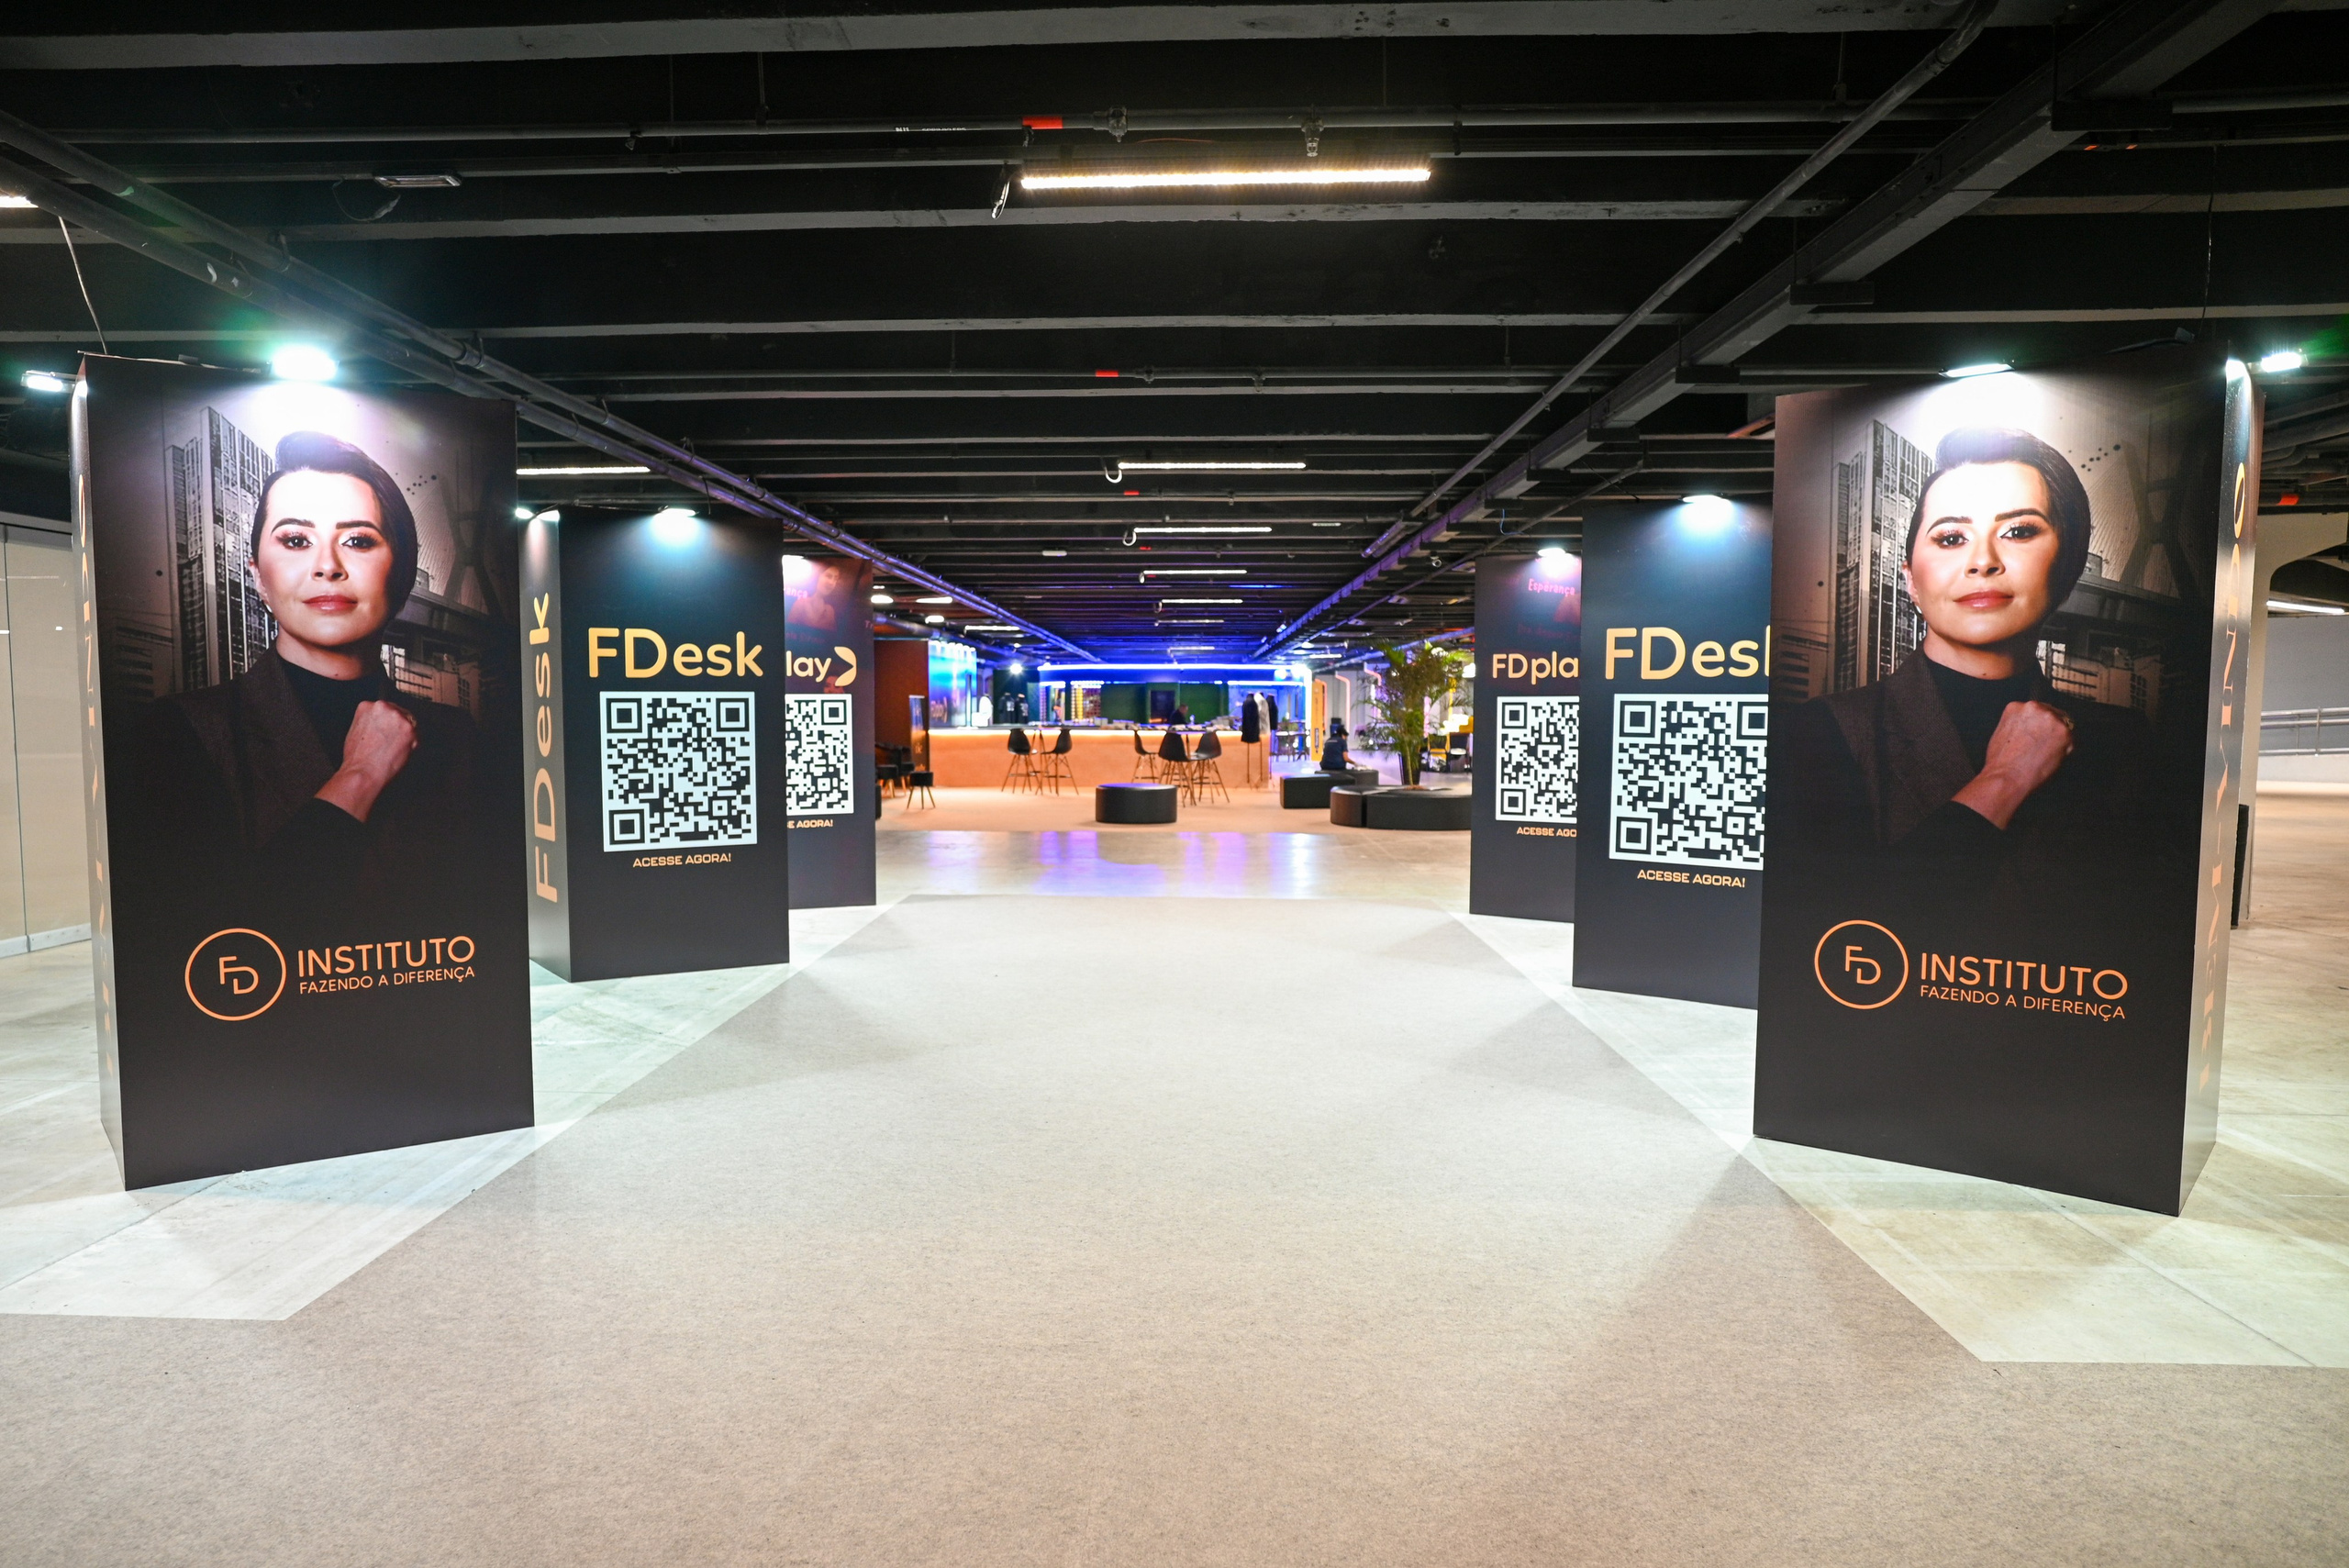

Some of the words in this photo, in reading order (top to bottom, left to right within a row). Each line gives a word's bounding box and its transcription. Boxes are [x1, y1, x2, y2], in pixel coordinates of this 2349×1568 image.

[588, 627, 763, 678] FDesk
[1492, 651, 1579, 685] FDpla
[1605, 625, 1770, 680] FDes
[529, 593, 558, 903] FDesk
[796, 819, 833, 828] AGORA!
[1517, 827, 1554, 837] ACESSE
[1556, 828, 1577, 838] AGO
[633, 855, 683, 868] ACESSE
[685, 853, 731, 865] AGORA!
[1637, 869, 1689, 884] ACESSE
[1692, 873, 1746, 888] AGORA!
[297, 935, 475, 977] INSTITUTO
[299, 975, 373, 995] FAZENDO
[378, 973, 389, 986] A
[394, 966, 475, 985] DIFERENÇA
[1921, 952, 2128, 1000] INSTITUTO
[1920, 984, 1999, 1006] FAZENDO
[2005, 995, 2018, 1007] A
[2023, 996, 2126, 1021] DIFERENÇA
